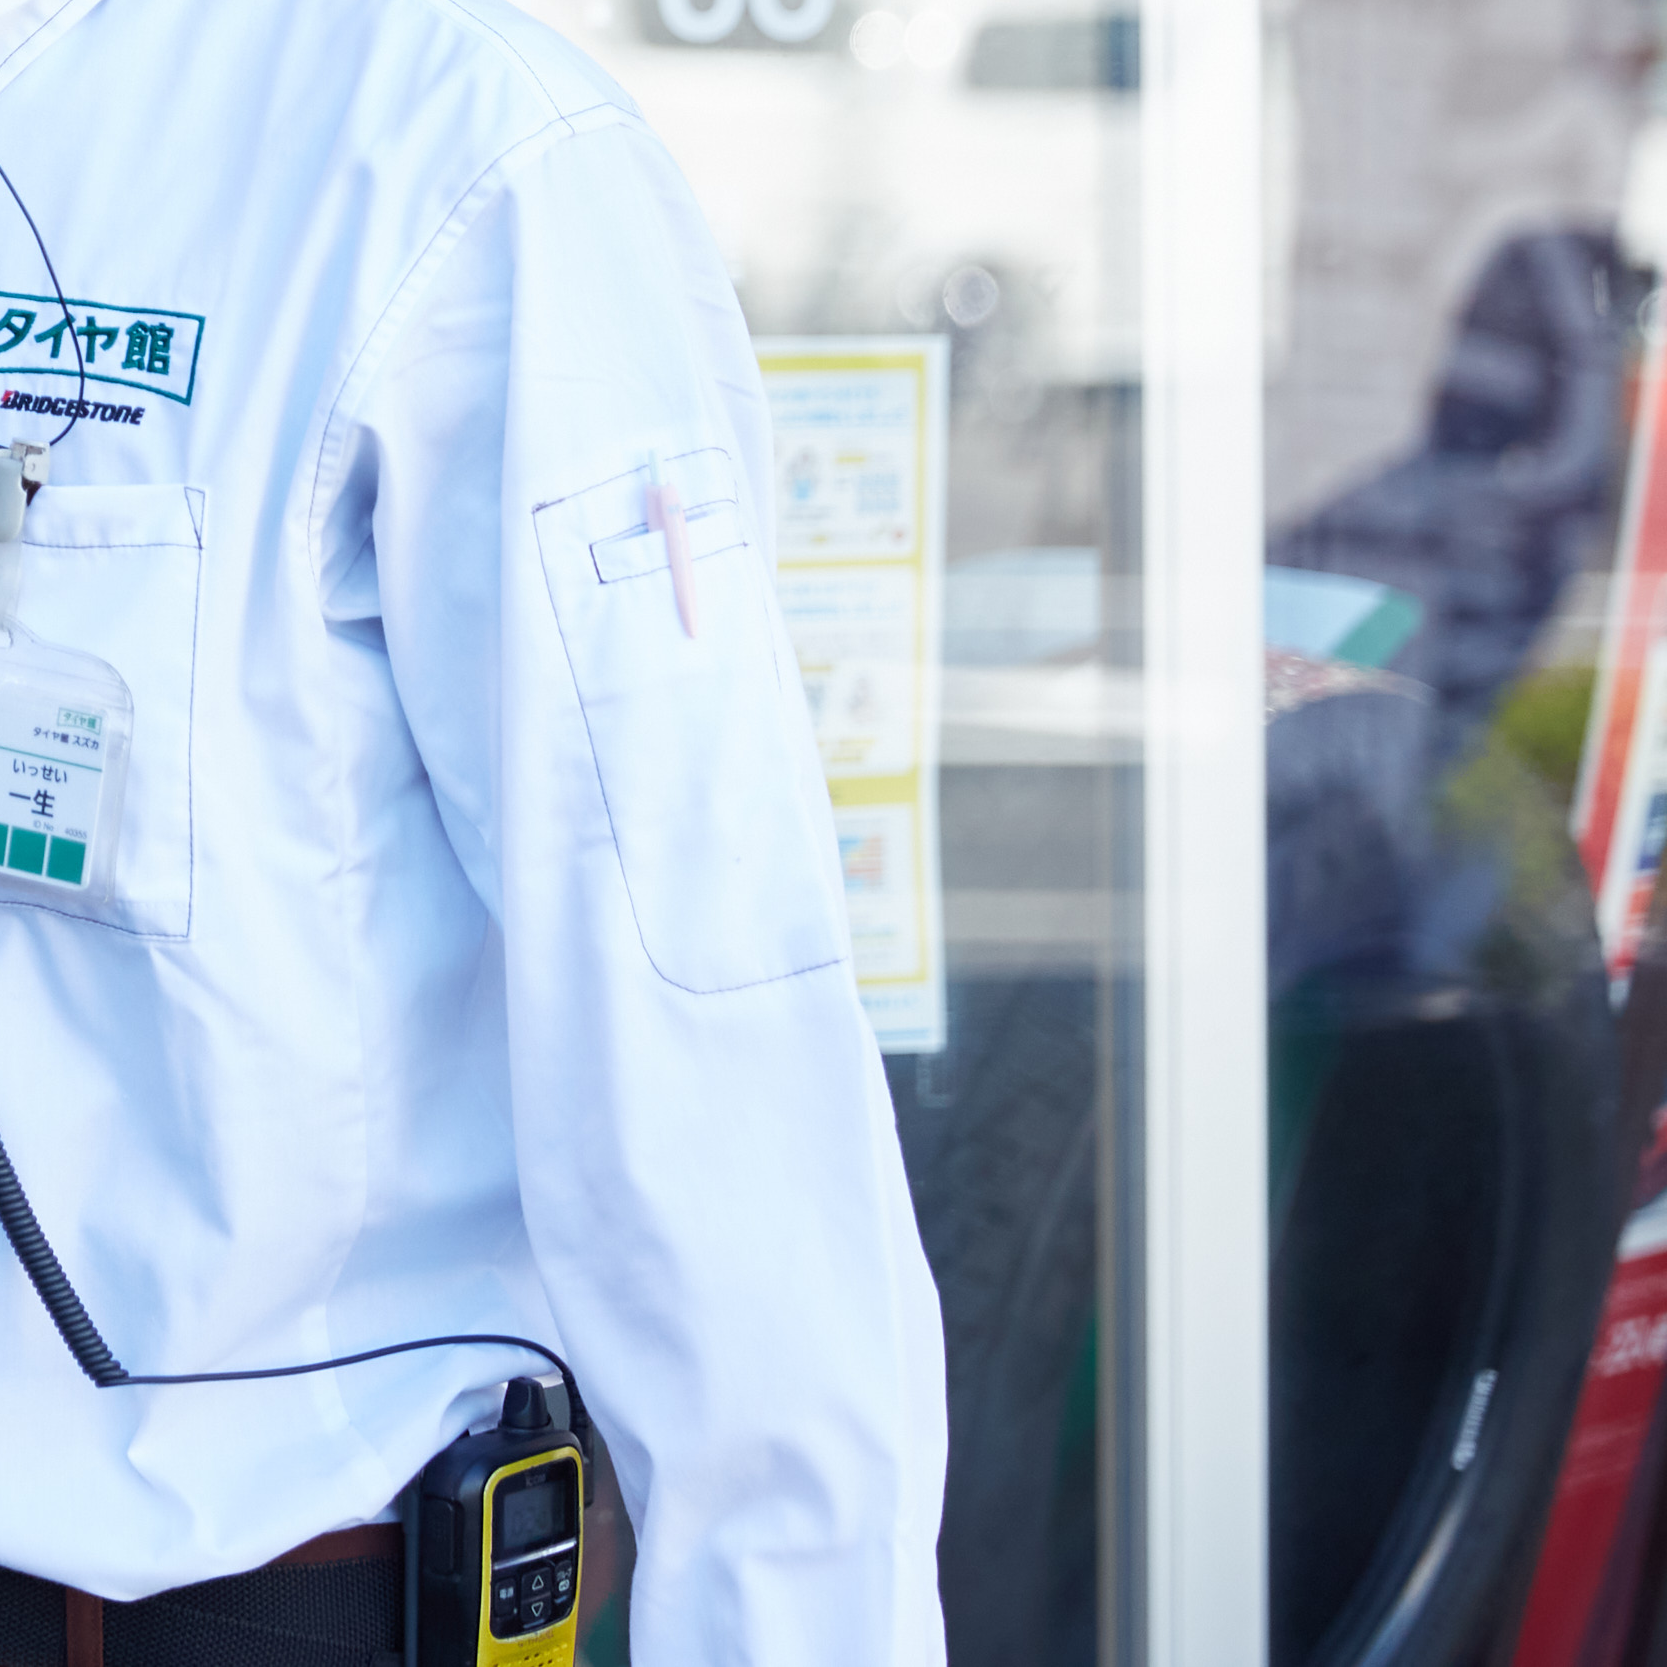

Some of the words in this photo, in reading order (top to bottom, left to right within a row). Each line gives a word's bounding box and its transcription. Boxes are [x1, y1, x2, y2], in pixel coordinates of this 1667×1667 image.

[0, 390, 145, 425] BRIDGESTONE
[72, 734, 100, 750] スズカ
[13, 758, 68, 783] いっせい
[8, 789, 56, 818] 一生
